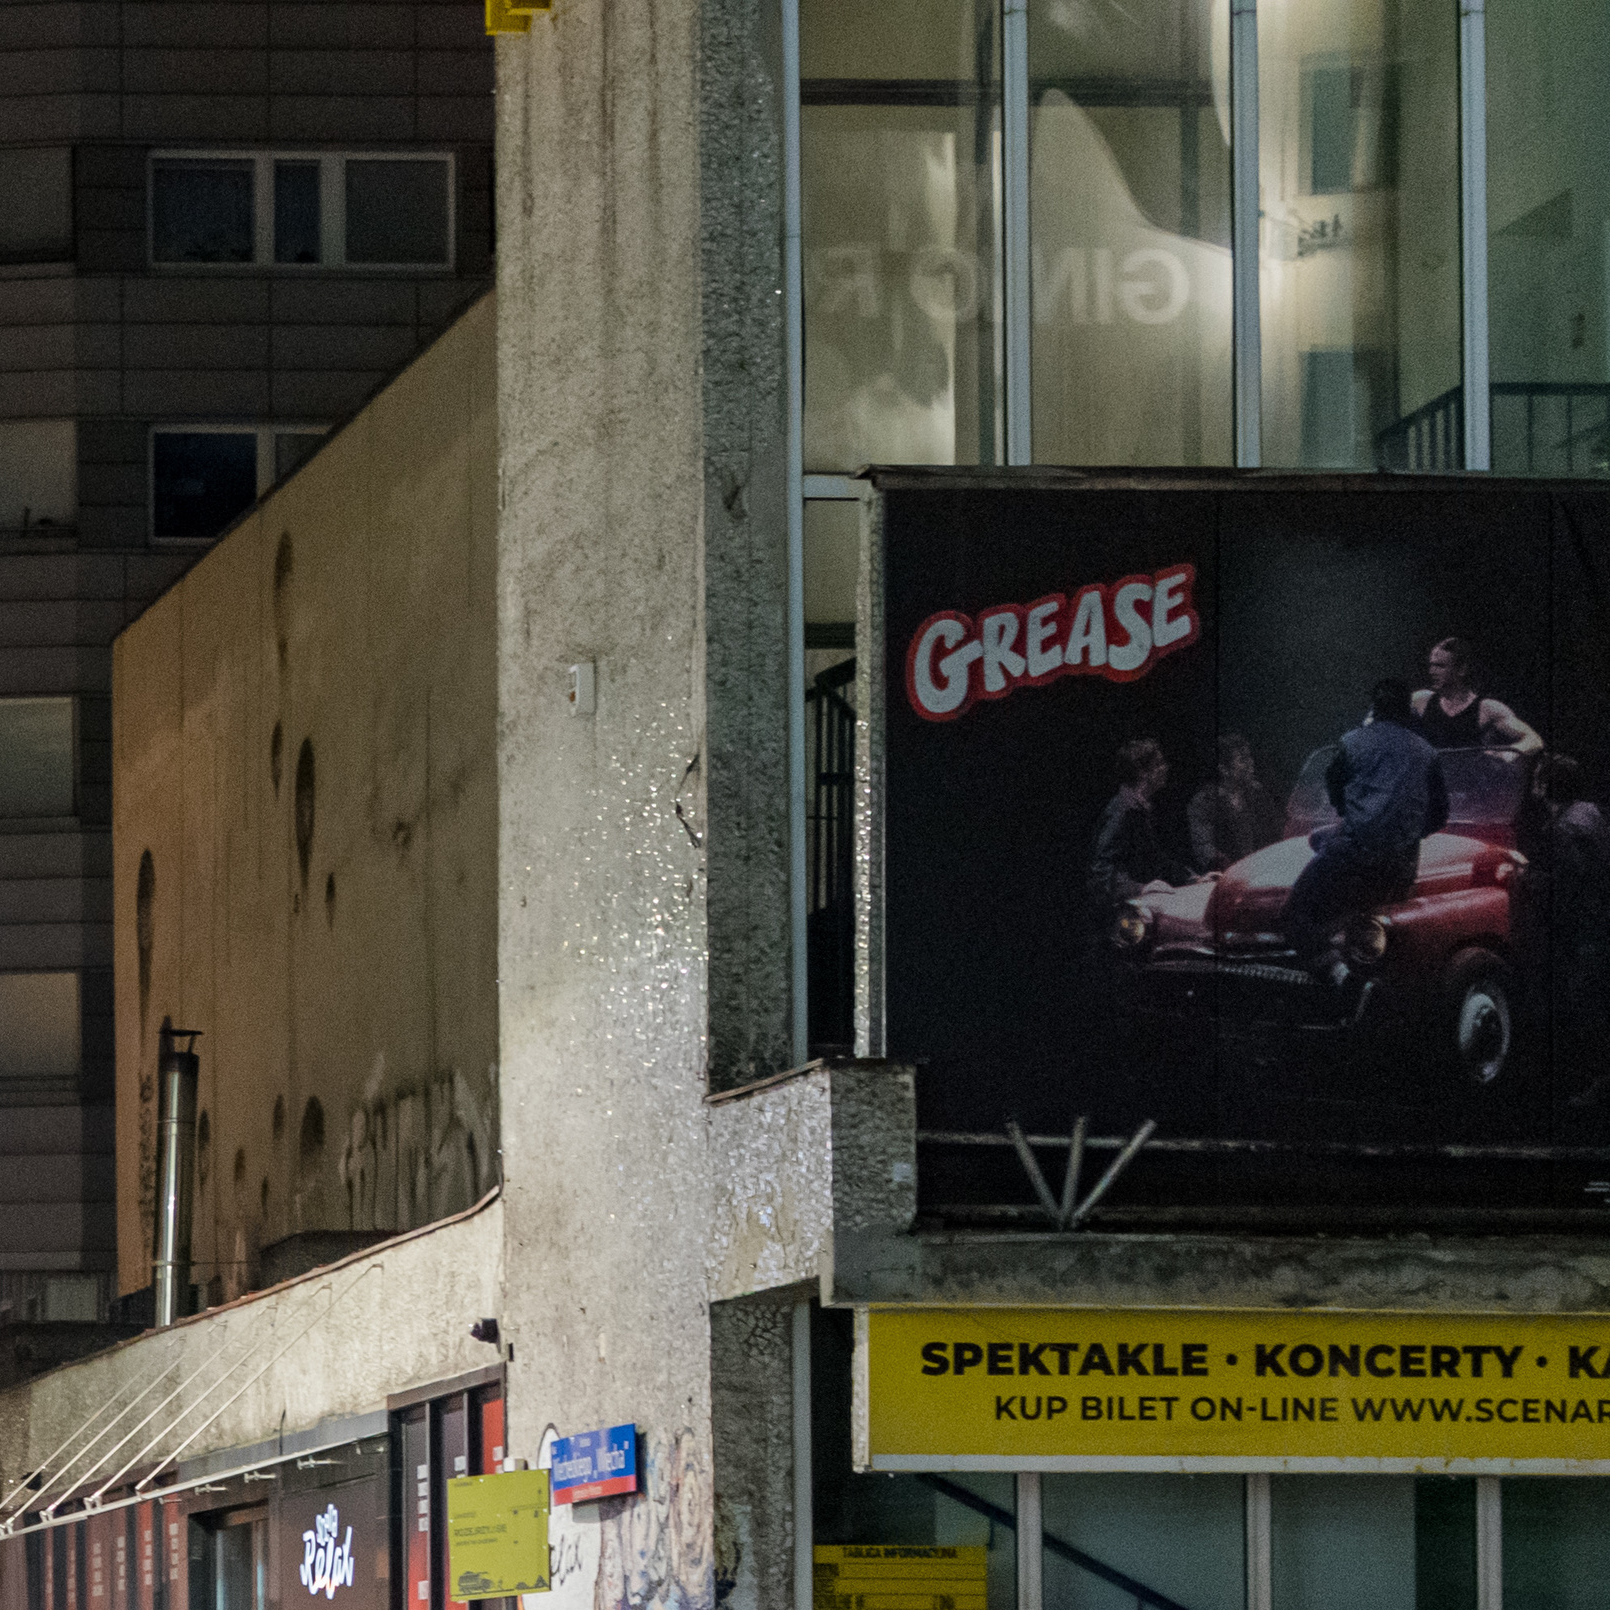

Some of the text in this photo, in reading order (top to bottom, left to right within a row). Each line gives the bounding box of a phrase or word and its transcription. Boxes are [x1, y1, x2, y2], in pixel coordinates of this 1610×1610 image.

[911, 569, 1196, 718] GREASE
[920, 1341, 1210, 1377] SPEKTAKLE
[1254, 1342, 1524, 1379] KONCERTY
[995, 1396, 1068, 1422] KUP
[1081, 1396, 1179, 1422] BILET
[1190, 1396, 1340, 1422] ON-LINE
[299, 1526, 355, 1600] Relax
[842, 1547, 881, 1558] TABLICA
